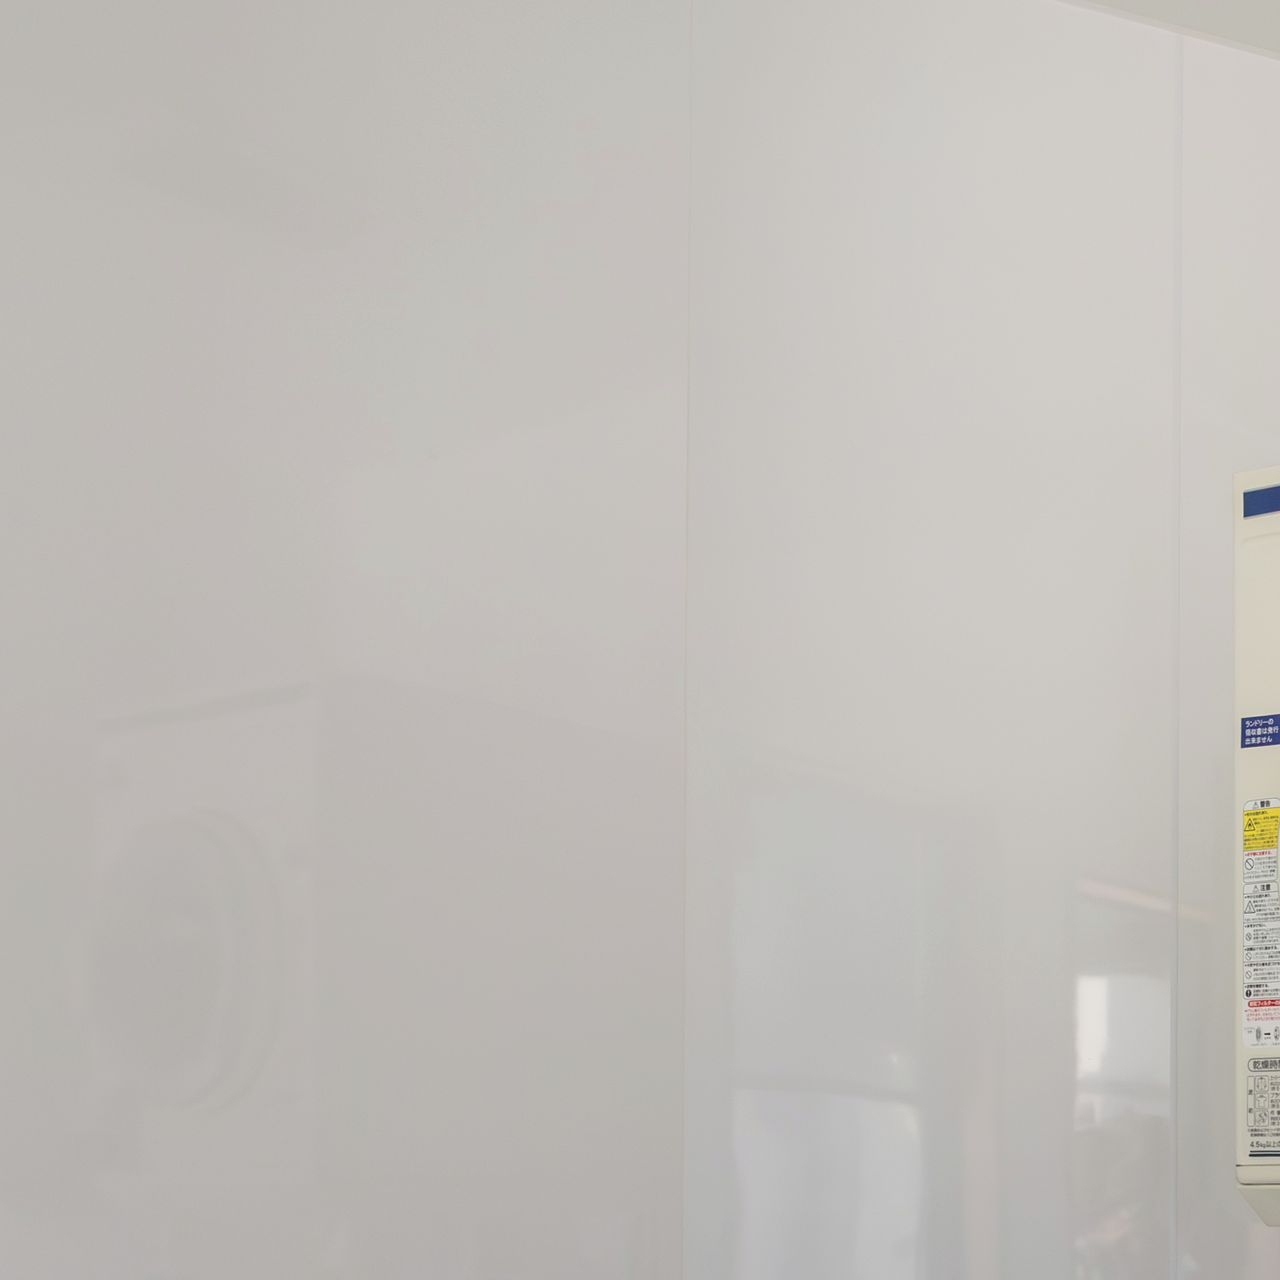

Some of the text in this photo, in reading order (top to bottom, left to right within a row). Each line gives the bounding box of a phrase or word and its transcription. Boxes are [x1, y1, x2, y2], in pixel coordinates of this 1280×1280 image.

[1245, 719, 1274, 728] ランドリーの
[1245, 726, 1279, 736] 領収書は発行
[1245, 737, 1273, 745] 出来ません
